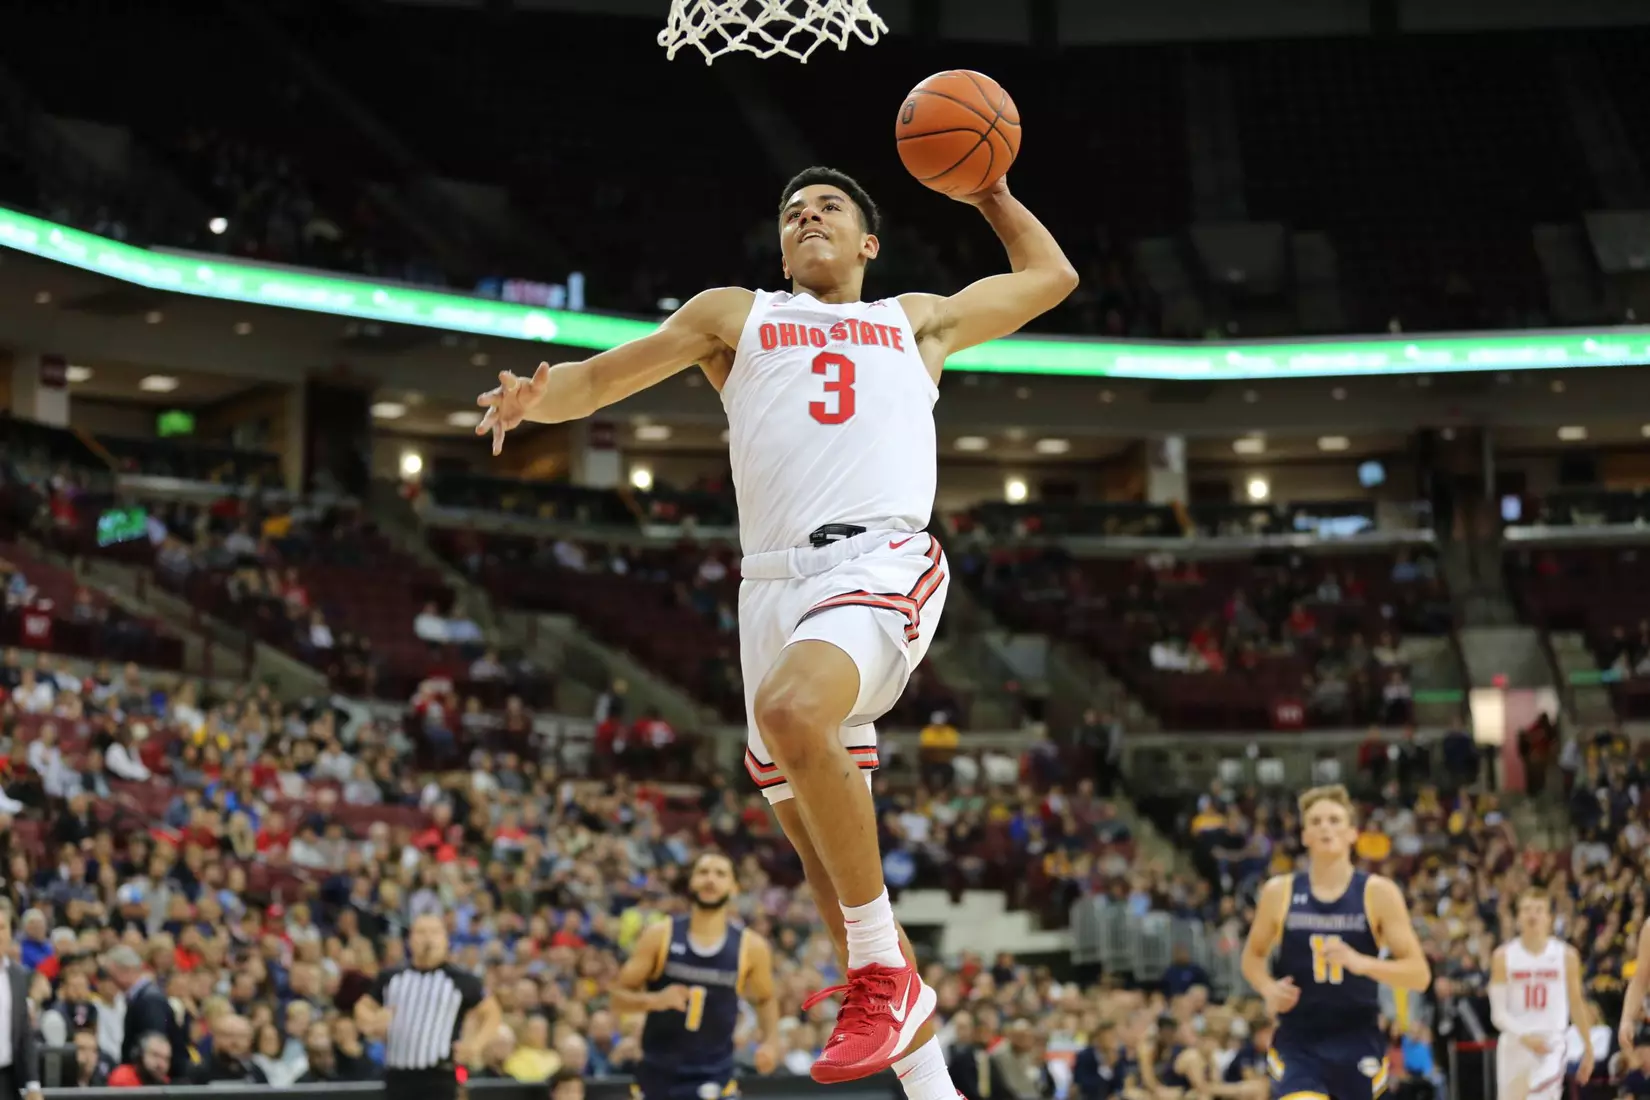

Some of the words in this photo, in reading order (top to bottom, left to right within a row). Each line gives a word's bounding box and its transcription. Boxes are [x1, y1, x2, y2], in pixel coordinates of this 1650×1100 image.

[759, 323, 827, 351] OHIO
[830, 318, 905, 353] STATE
[808, 351, 856, 425] 3
[1524, 983, 1547, 1010] 10
